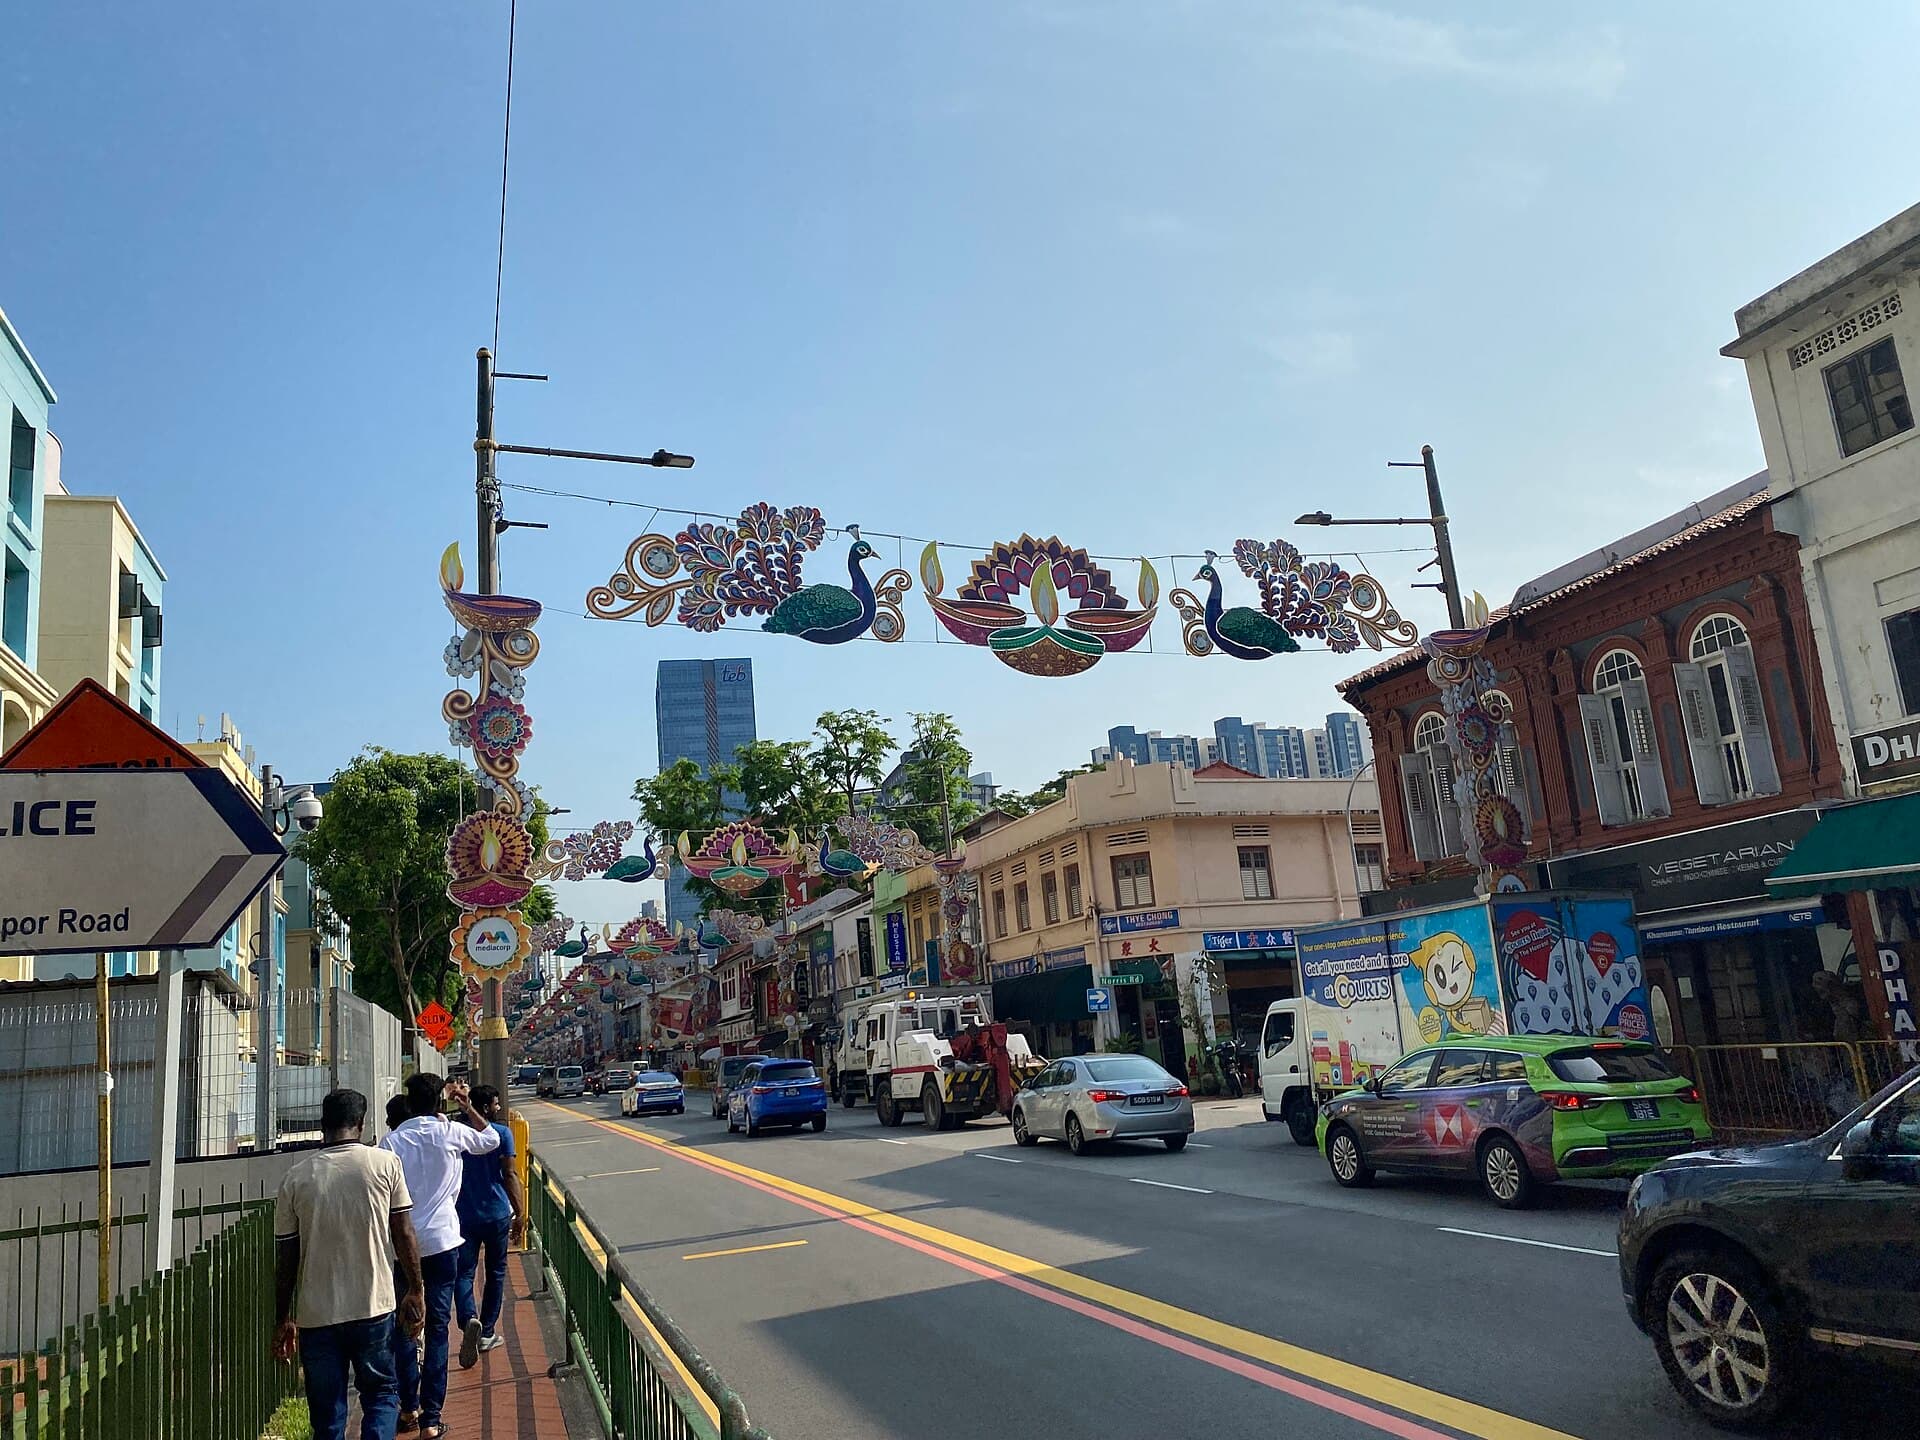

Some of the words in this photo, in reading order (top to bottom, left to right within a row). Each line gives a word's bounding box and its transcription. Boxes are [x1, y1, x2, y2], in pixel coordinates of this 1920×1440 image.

[1864, 733, 1920, 767] DH
[0, 801, 96, 836] ICE
[1648, 839, 1795, 876] VEGETARIAN
[58, 907, 129, 933] Road
[1125, 914, 1145, 924] THYE
[1147, 911, 1173, 921] CHONG
[1788, 911, 1813, 922] NETS
[1716, 918, 1761, 931] Restaurant
[1212, 935, 1233, 948] Tiger
[1305, 961, 1320, 976] Get
[1320, 959, 1330, 973] all
[1330, 959, 1345, 977] you
[1345, 956, 1366, 971] need
[1366, 954, 1383, 969] and
[1101, 976, 1127, 985] Norris
[1129, 975, 1140, 984] Rd
[1325, 985, 1334, 998] at
[1337, 979, 1390, 1000] COURTS
[421, 1013, 446, 1025] SLOW
[1619, 1018, 1646, 1029] PRICES
